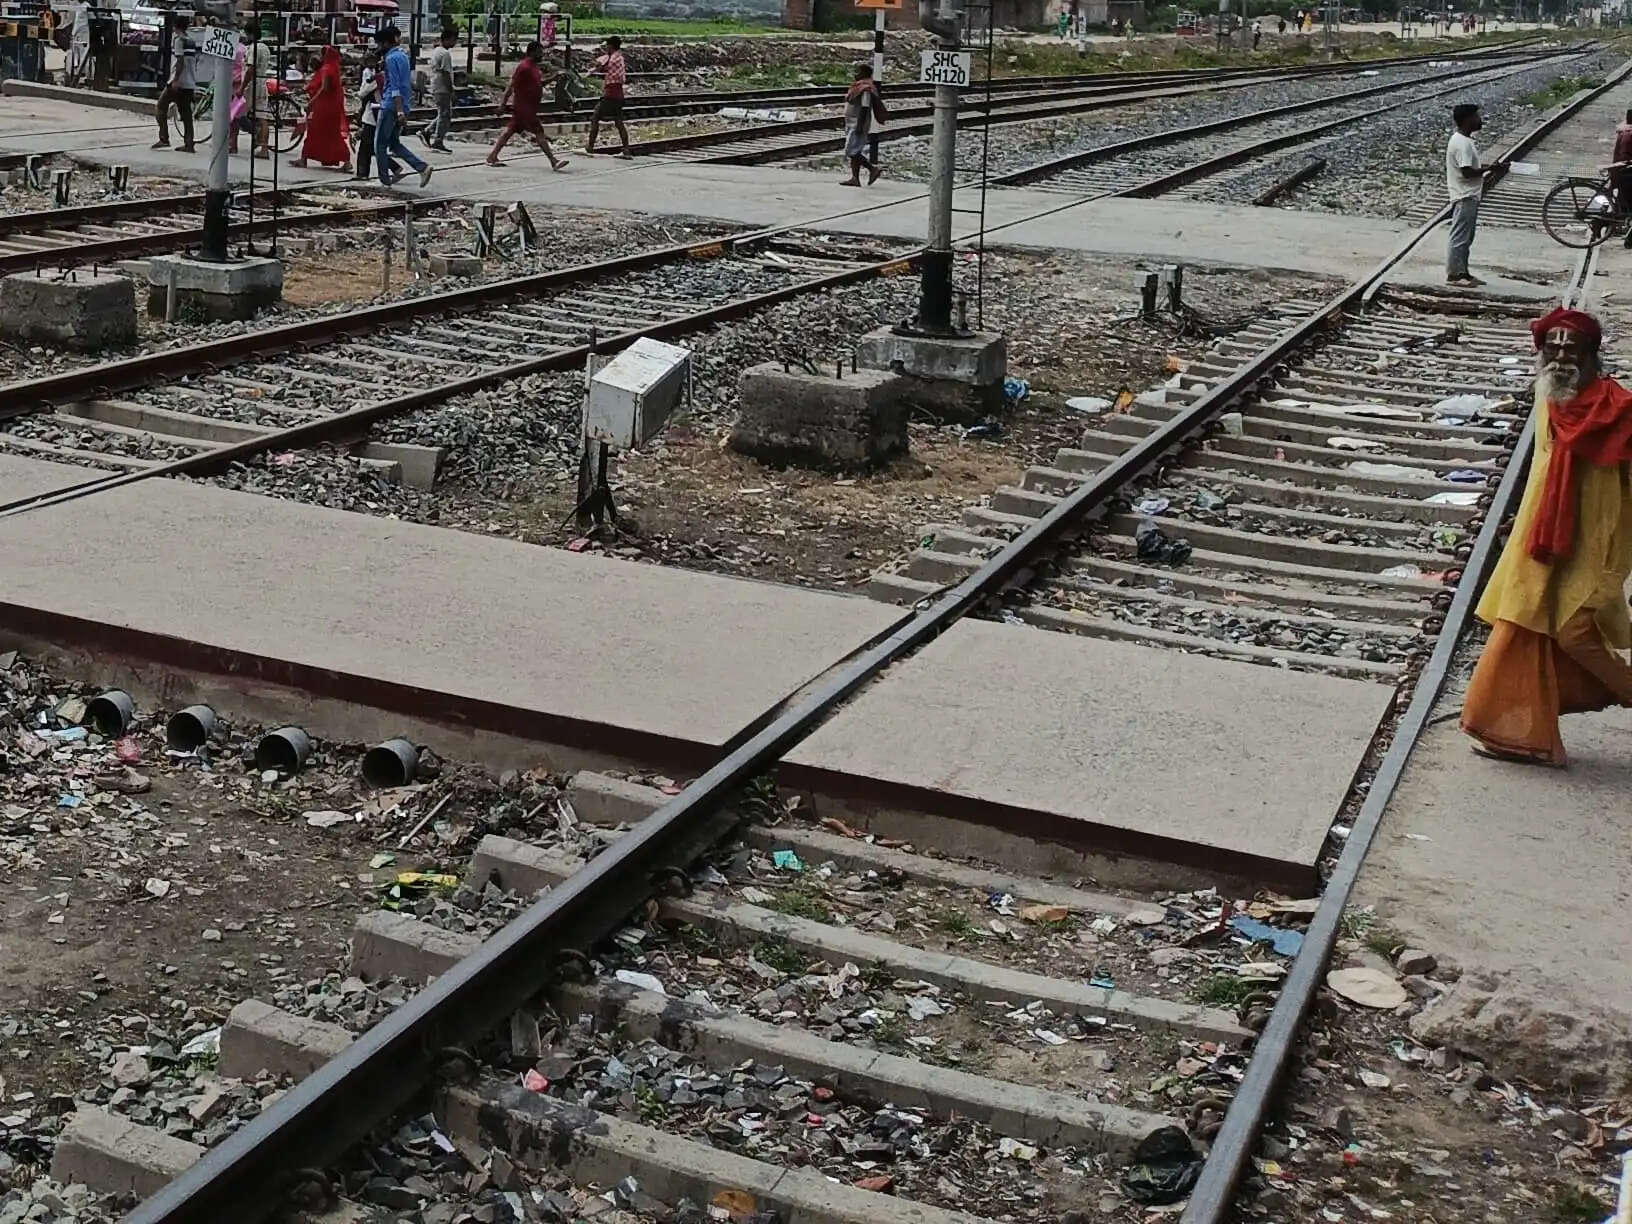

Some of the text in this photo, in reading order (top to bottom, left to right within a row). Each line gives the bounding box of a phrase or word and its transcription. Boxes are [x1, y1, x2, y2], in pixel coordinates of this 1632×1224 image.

[213, 28, 233, 44] SHC
[205, 40, 234, 58] SH114
[933, 51, 959, 67] SHC
[924, 67, 966, 85] SH120
